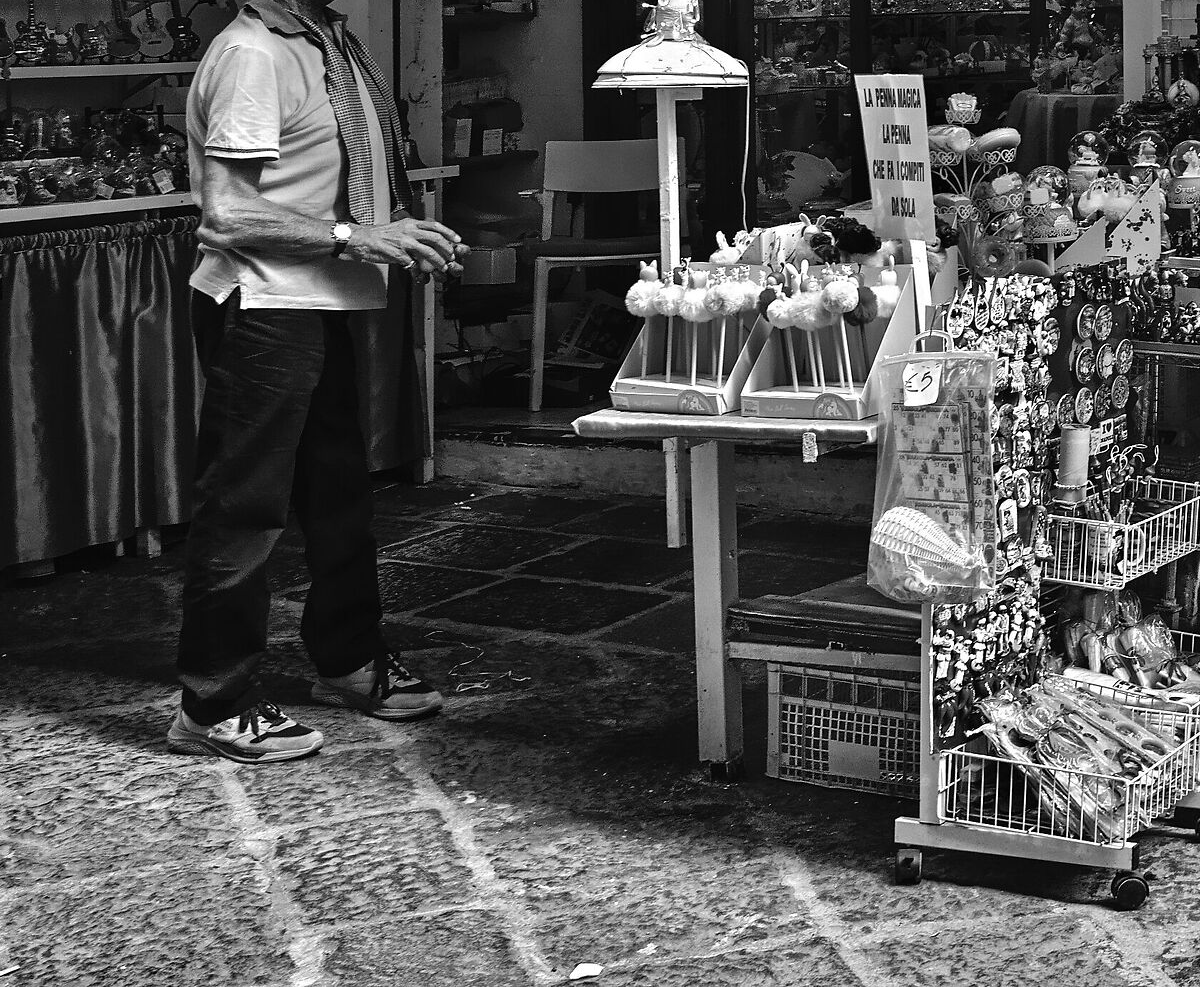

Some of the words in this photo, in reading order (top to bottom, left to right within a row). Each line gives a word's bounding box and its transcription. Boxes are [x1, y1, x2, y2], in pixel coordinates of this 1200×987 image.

[863, 88, 873, 108] LA
[875, 88, 896, 108] PENNA
[897, 88, 921, 109] MAGICA
[882, 124, 890, 144] LA
[891, 124, 911, 145] PENNA
[873, 159, 885, 179] CHE
[887, 160, 895, 180] FA
[901, 161, 925, 182] COMPITI
[891, 196, 900, 217] DA
[901, 197, 916, 218] SOLA
